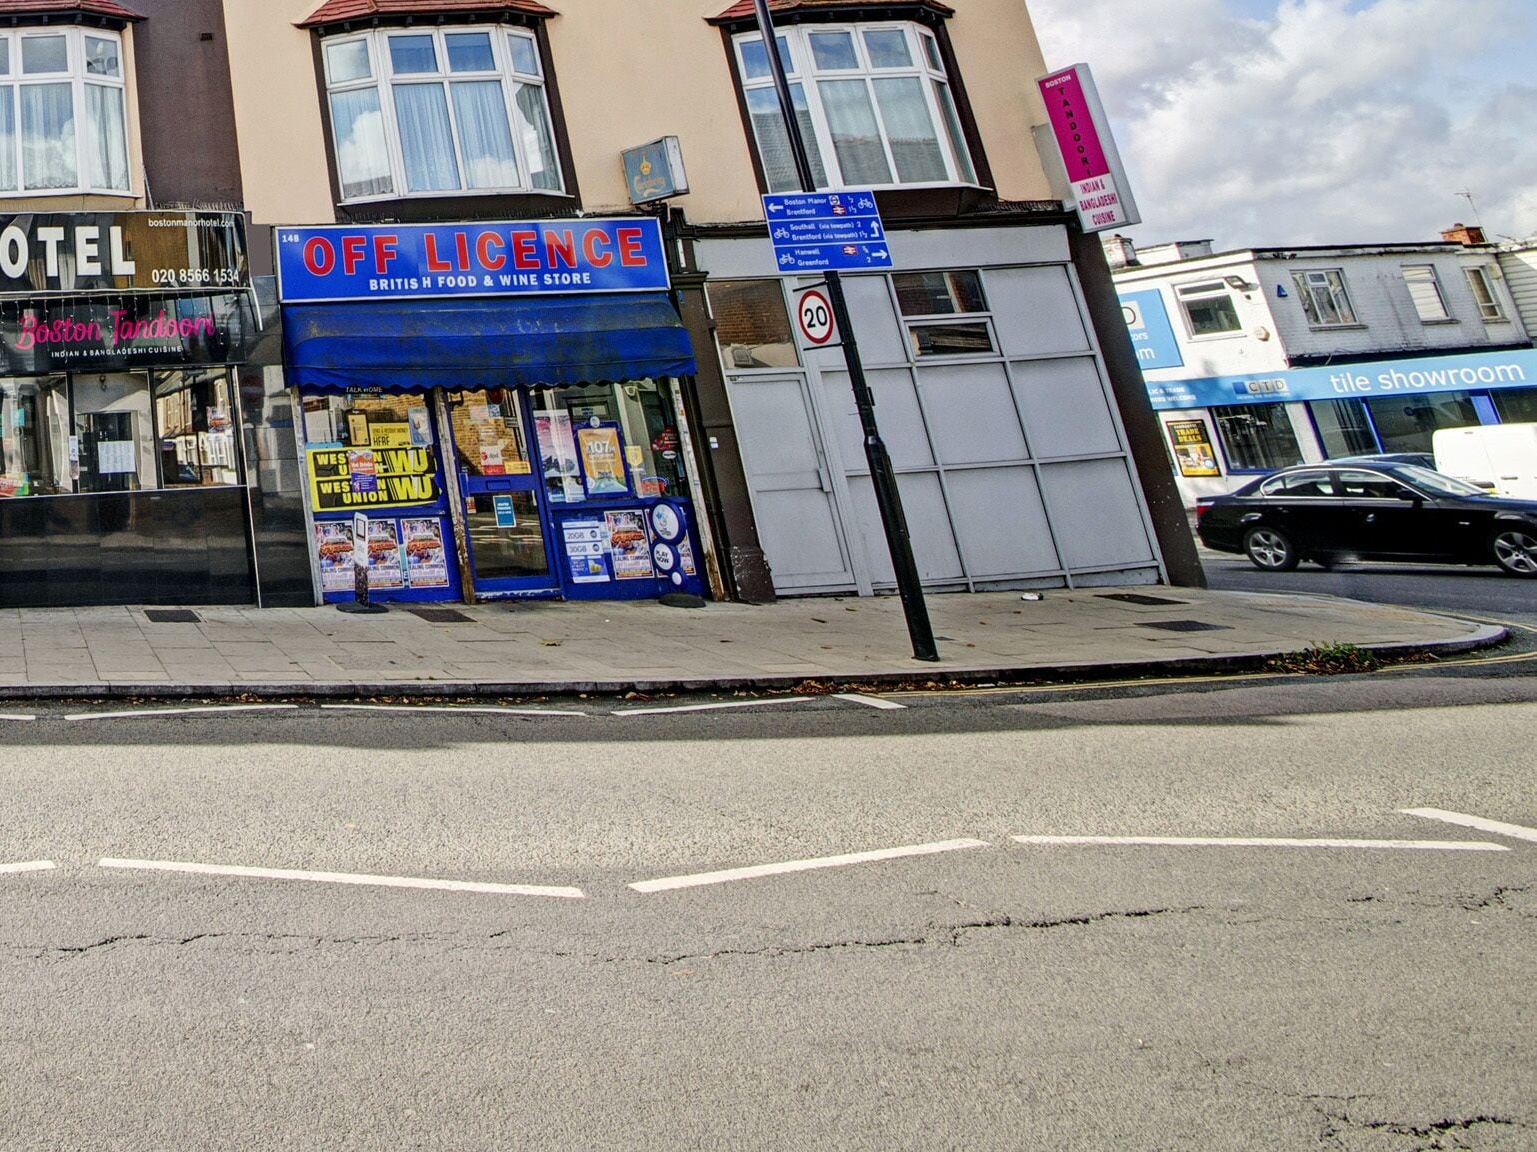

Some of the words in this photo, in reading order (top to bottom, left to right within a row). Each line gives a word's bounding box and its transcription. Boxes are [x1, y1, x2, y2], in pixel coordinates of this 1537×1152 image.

[1045, 74, 1071, 88] BOSTON
[1058, 87, 1091, 177] TANDOORI
[1080, 180, 1099, 194] INDIAN
[1100, 179, 1106, 190] &
[1079, 193, 1118, 212] BANGLADESHI
[148, 217, 234, 227] bostonmanorhotel.com
[1092, 211, 1116, 225] CUISINE
[303, 234, 398, 276] OFF
[424, 228, 648, 272] LICENCE
[151, 269, 175, 283] 020
[179, 268, 210, 282] 8566
[213, 268, 239, 282] 1534
[369, 276, 431, 291] BRITISH
[438, 274, 477, 288] FOOD
[483, 274, 494, 286] &
[499, 273, 538, 286] WINE
[543, 272, 591, 285] STORE
[804, 305, 828, 328] 20
[15, 314, 101, 351] Boston
[111, 308, 216, 346] Tandoori
[51, 350, 80, 358] INDIAN
[82, 349, 88, 357] &
[89, 347, 147, 357] BANGLADESHI
[148, 345, 182, 354] CUISINE
[1330, 371, 1372, 394] tile
[1377, 363, 1526, 390] showroom
[1248, 380, 1285, 393] CTD
[316, 451, 384, 466] WESN
[319, 478, 387, 494] WESN
[343, 490, 388, 504] UNION
